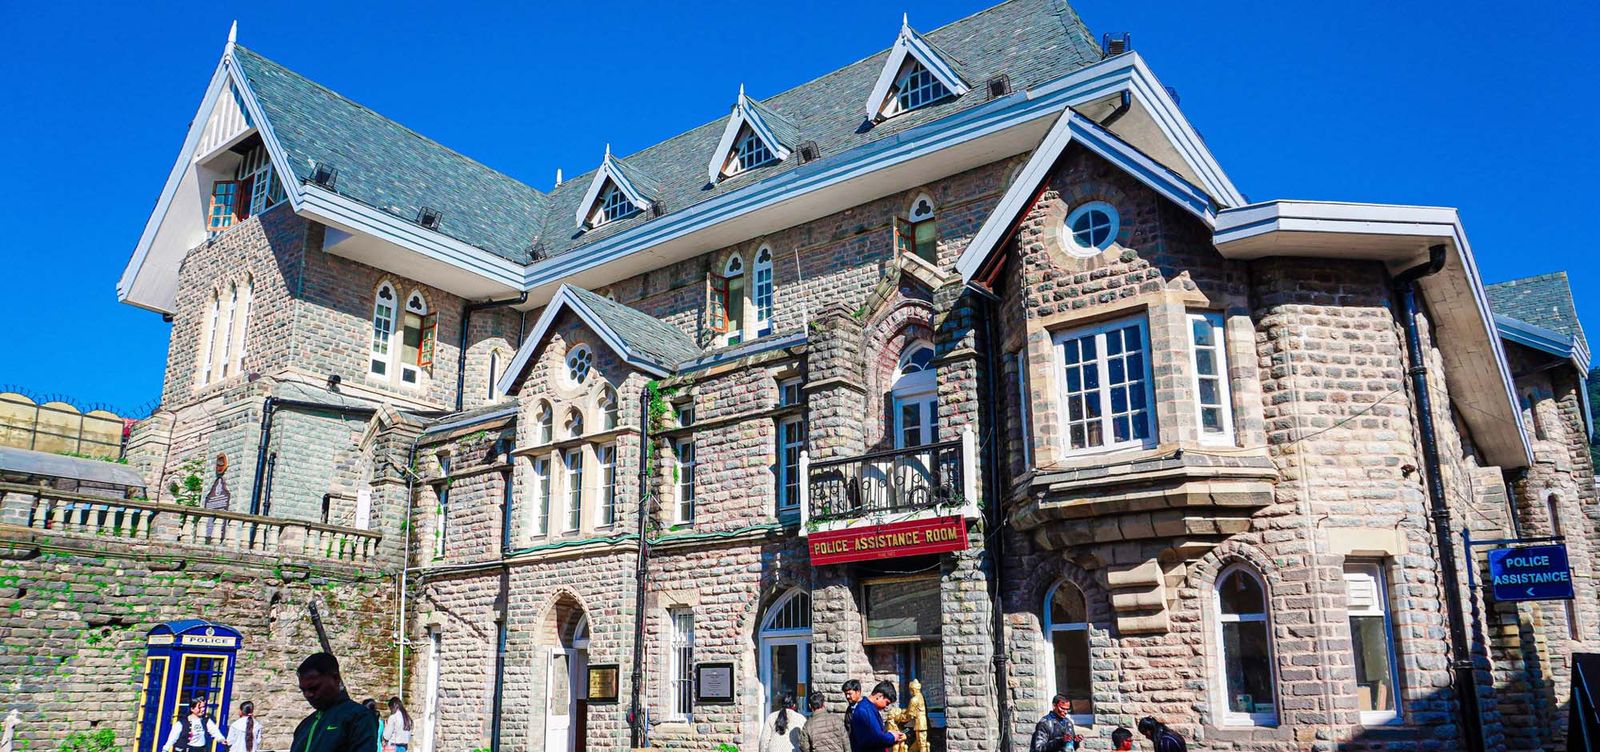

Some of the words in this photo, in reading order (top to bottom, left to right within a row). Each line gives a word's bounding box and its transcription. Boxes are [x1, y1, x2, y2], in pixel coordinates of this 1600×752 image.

[814, 540, 848, 555] POLICE
[855, 531, 920, 550] ASSISTANCE
[925, 527, 957, 542] ROOM
[1506, 555, 1550, 568] POLICE
[1494, 571, 1569, 586] ASSISTANCE
